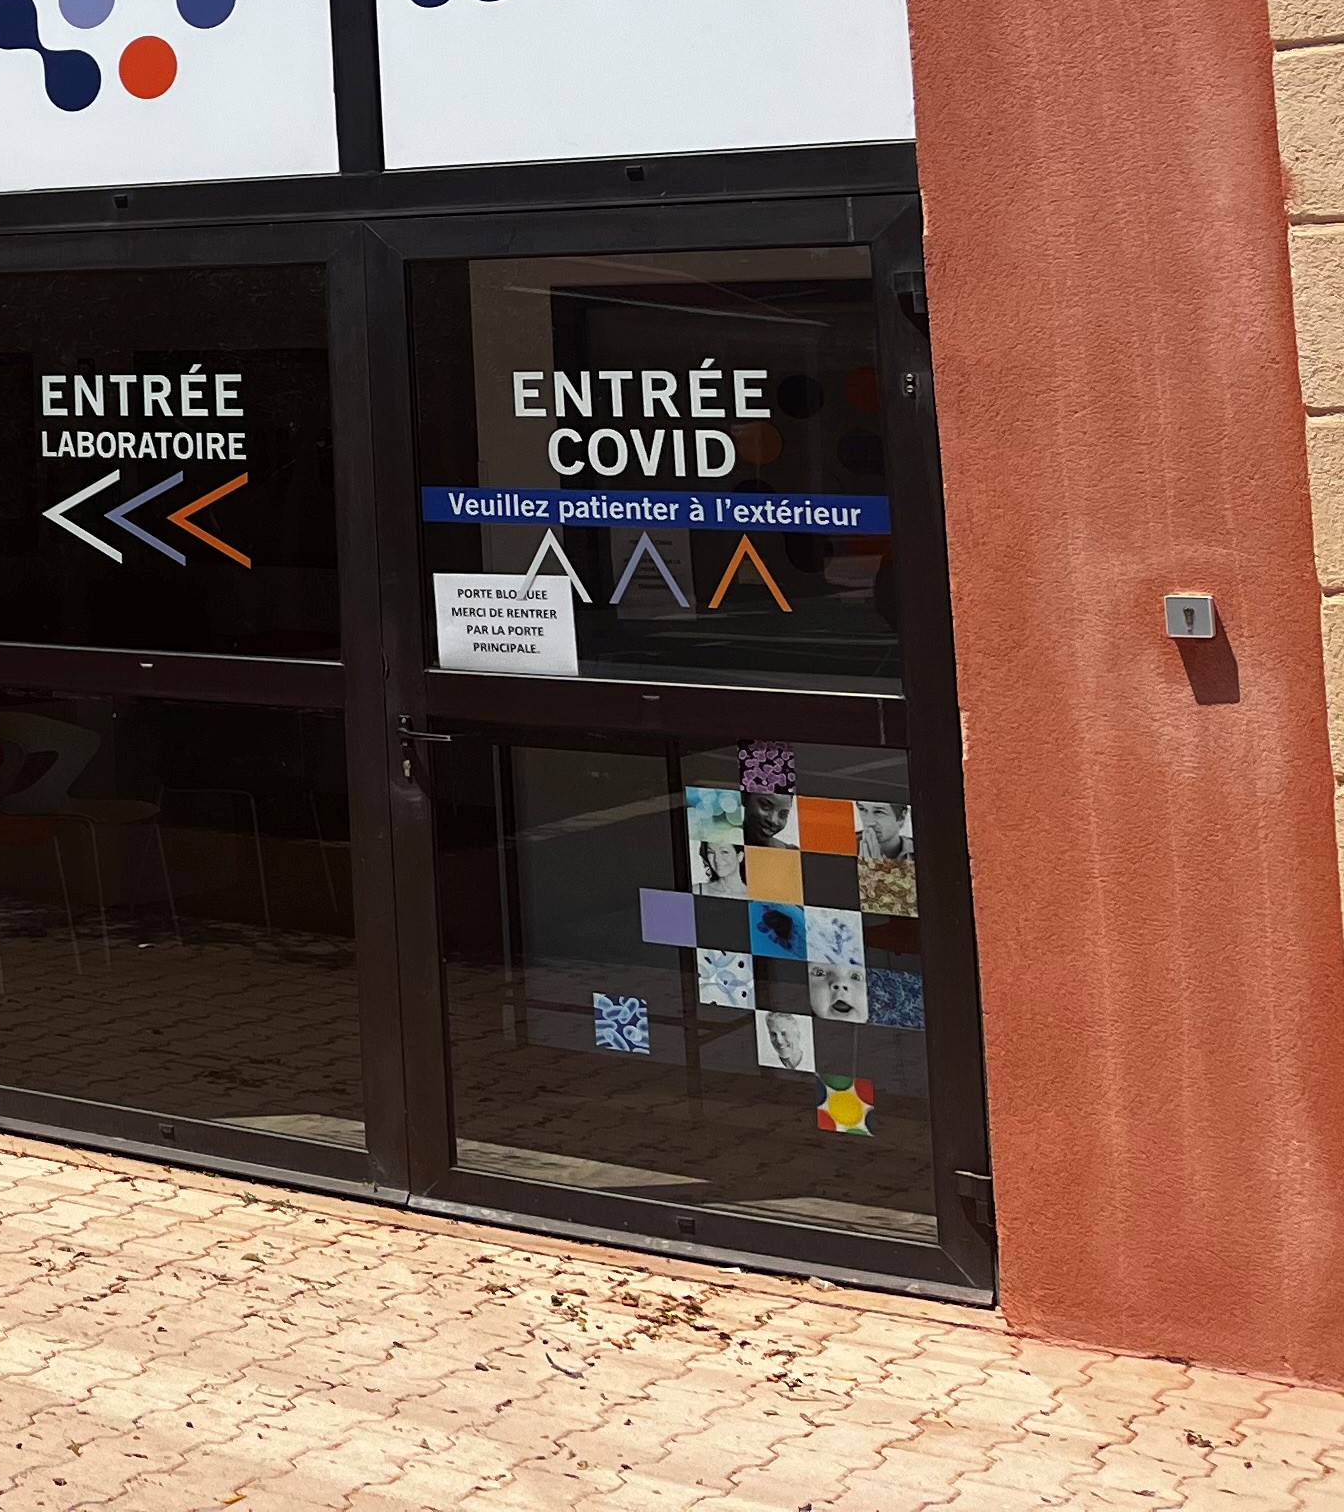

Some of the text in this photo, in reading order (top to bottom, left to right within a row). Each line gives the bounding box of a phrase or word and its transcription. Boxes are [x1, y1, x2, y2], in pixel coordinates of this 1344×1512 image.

[41, 363, 244, 417] ENTRÉE
[512, 358, 771, 419] ENTRÉE
[41, 430, 247, 460] LABORATOIRE
[548, 427, 737, 478] COVID
[447, 492, 861, 527] Veuillez patienter à l'extérieur
[457, 588, 548, 600] PORTE BLOUEE
[451, 607, 558, 620] MERCI DE RENTRER
[466, 624, 544, 637] PAR LA PORTE
[473, 642, 541, 654] PRINCIPALE.
